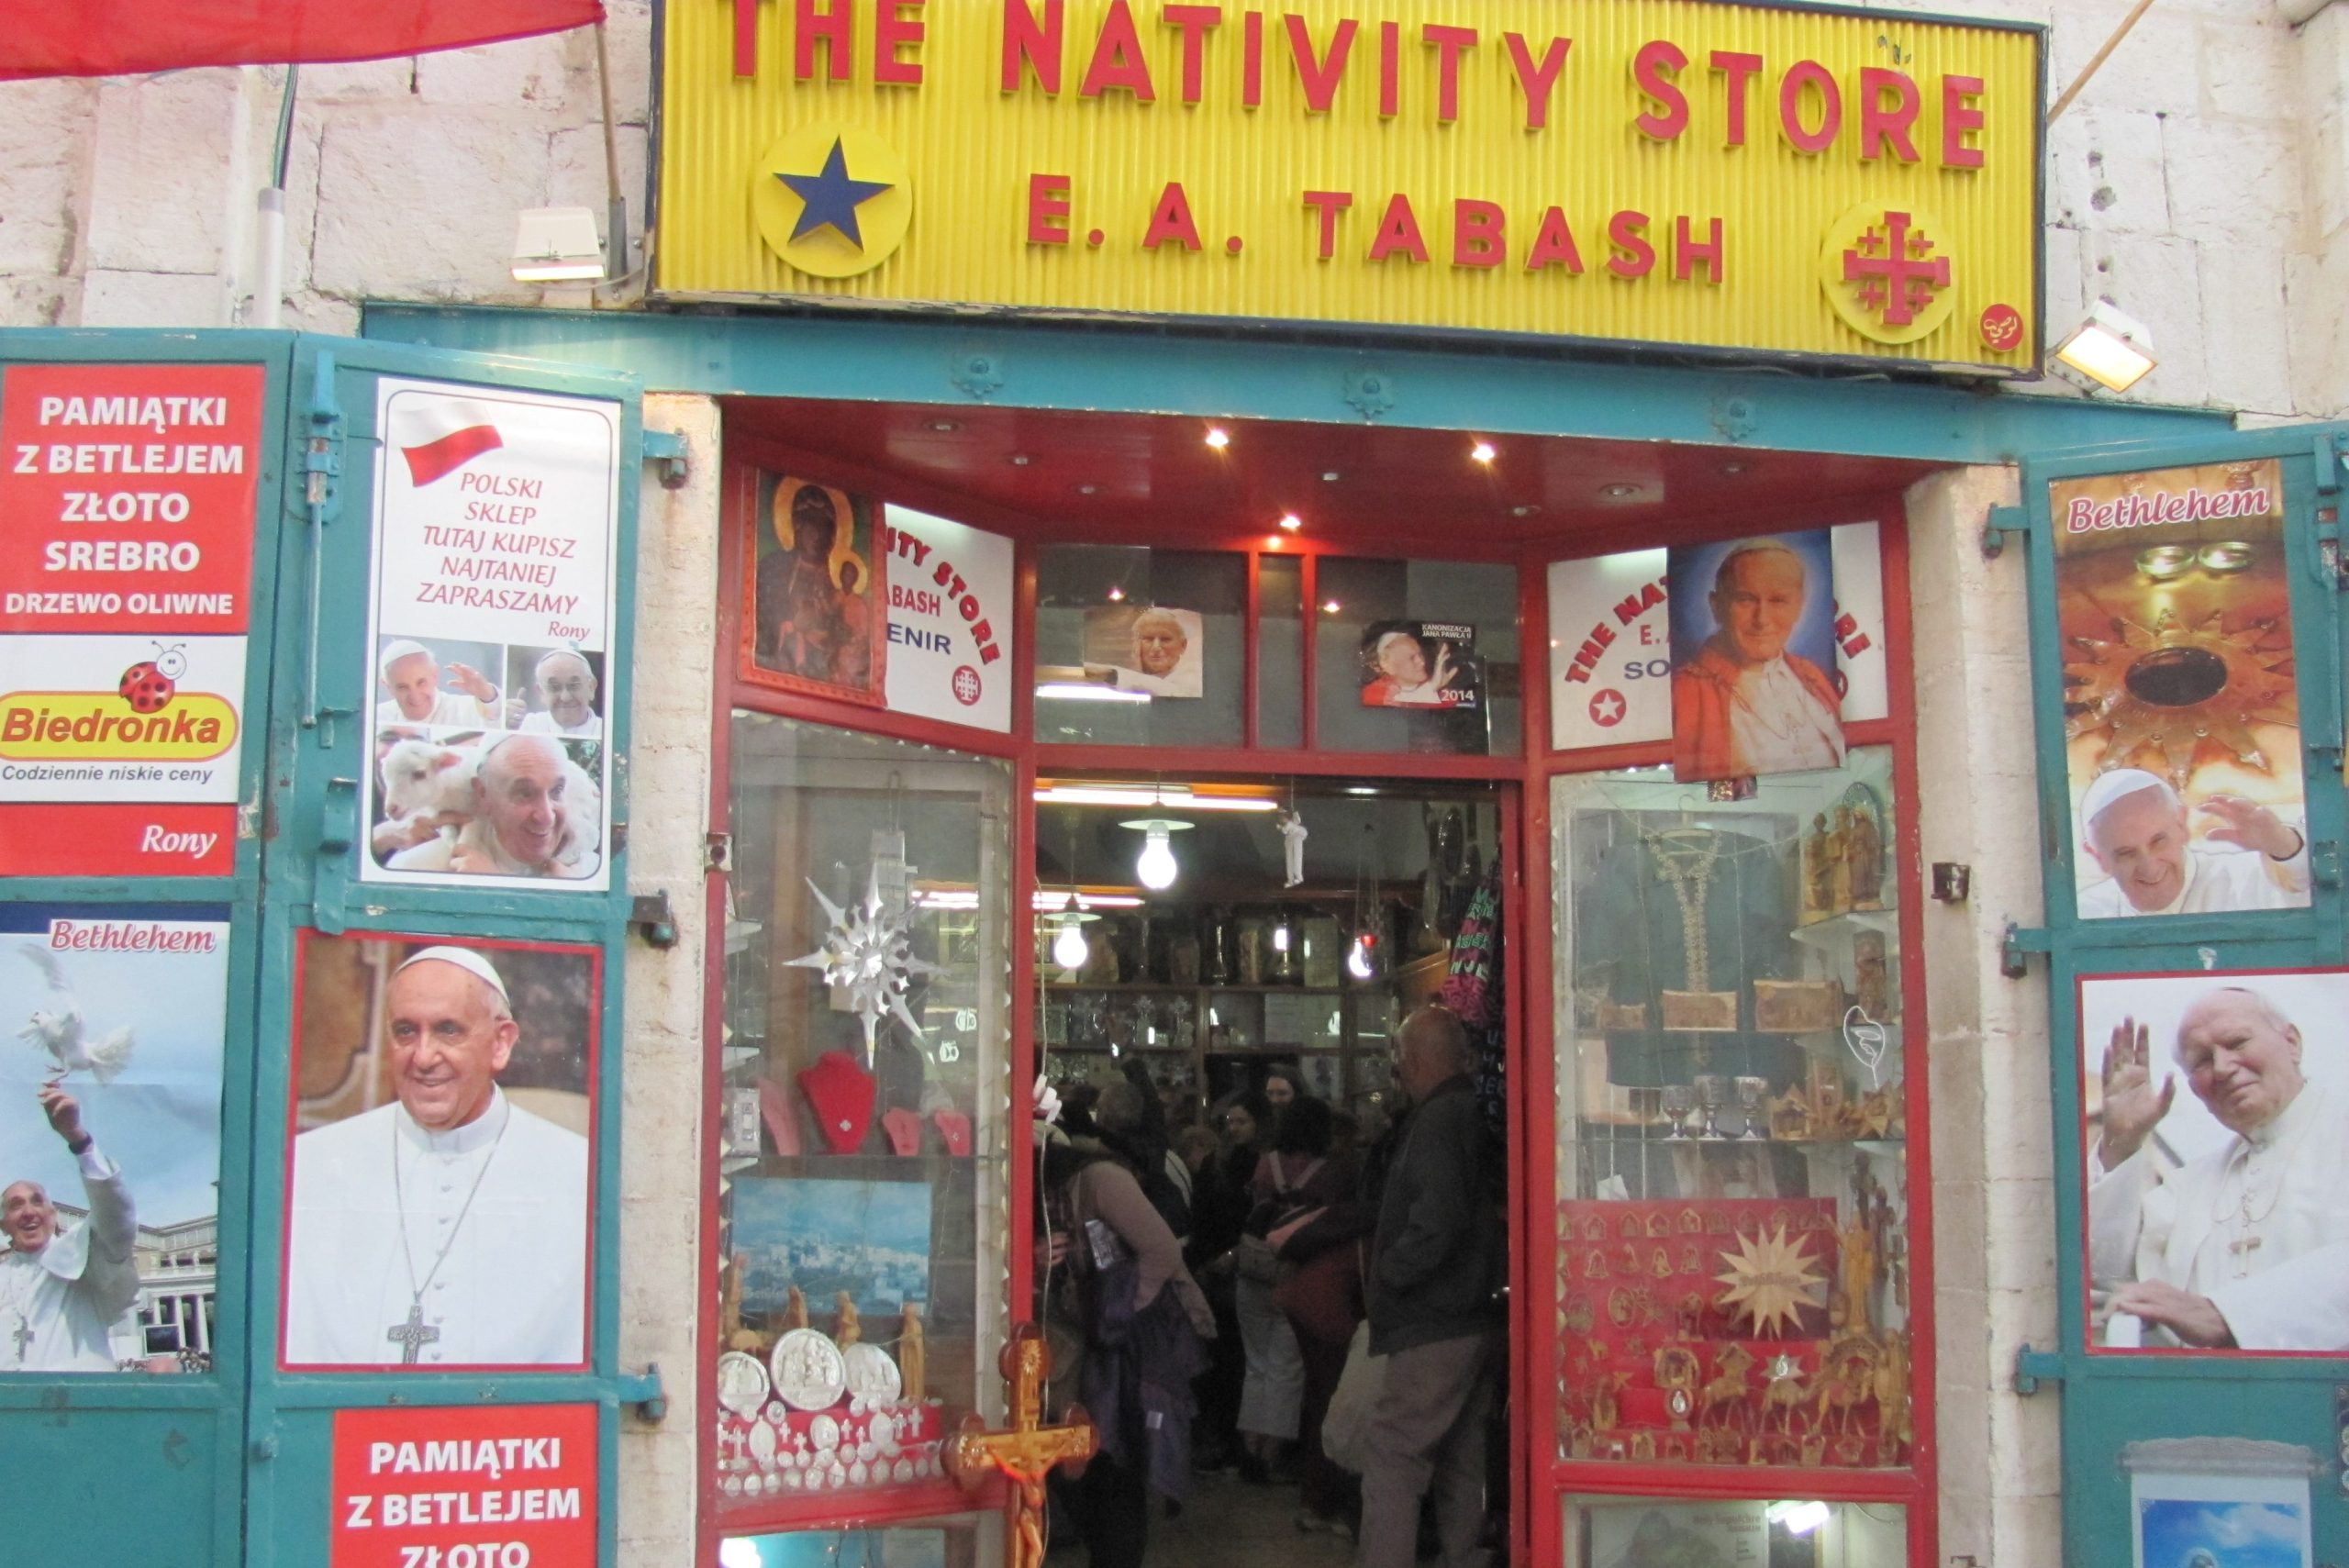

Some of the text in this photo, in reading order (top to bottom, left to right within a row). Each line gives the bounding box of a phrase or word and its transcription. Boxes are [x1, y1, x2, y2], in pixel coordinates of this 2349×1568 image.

[732, 0, 1985, 169] THE NATIVITY STORE
[1302, 190, 1723, 284] TABASH
[39, 396, 228, 435] PAMIĄTKI
[13, 444, 244, 474] Z BETLEJEM
[460, 472, 543, 499] POLSKI
[60, 492, 191, 523] ZŁOTO
[463, 501, 538, 526] SKLEP
[2067, 487, 2270, 534] Bethlehem
[44, 540, 201, 573] SREBRO
[423, 525, 577, 559] TUTAJ KUPISZ
[440, 555, 558, 588] NAJTANIEJ
[6, 593, 234, 615] DRZEWO OLIWNE
[416, 582, 580, 616] ZAPRASZAMY
[886, 526, 1001, 666] ITY STORE
[887, 584, 941, 617] BASH
[547, 620, 591, 642] Rony
[886, 621, 952, 656] ENIR
[1564, 621, 1618, 684] THE
[1613, 575, 1670, 627] NA
[1623, 659, 1672, 680] SO
[1441, 689, 1475, 702] 2014
[2, 707, 222, 743] Biedronka
[2, 765, 214, 785] Codziennie niskie ceny
[141, 824, 217, 860] Rony
[50, 920, 217, 954] Bethlehem
[370, 1438, 561, 1480] PAMIĄTKI
[346, 1487, 581, 1528] Z BETLEJEM
[400, 1541, 530, 1568] ZŁOTO
